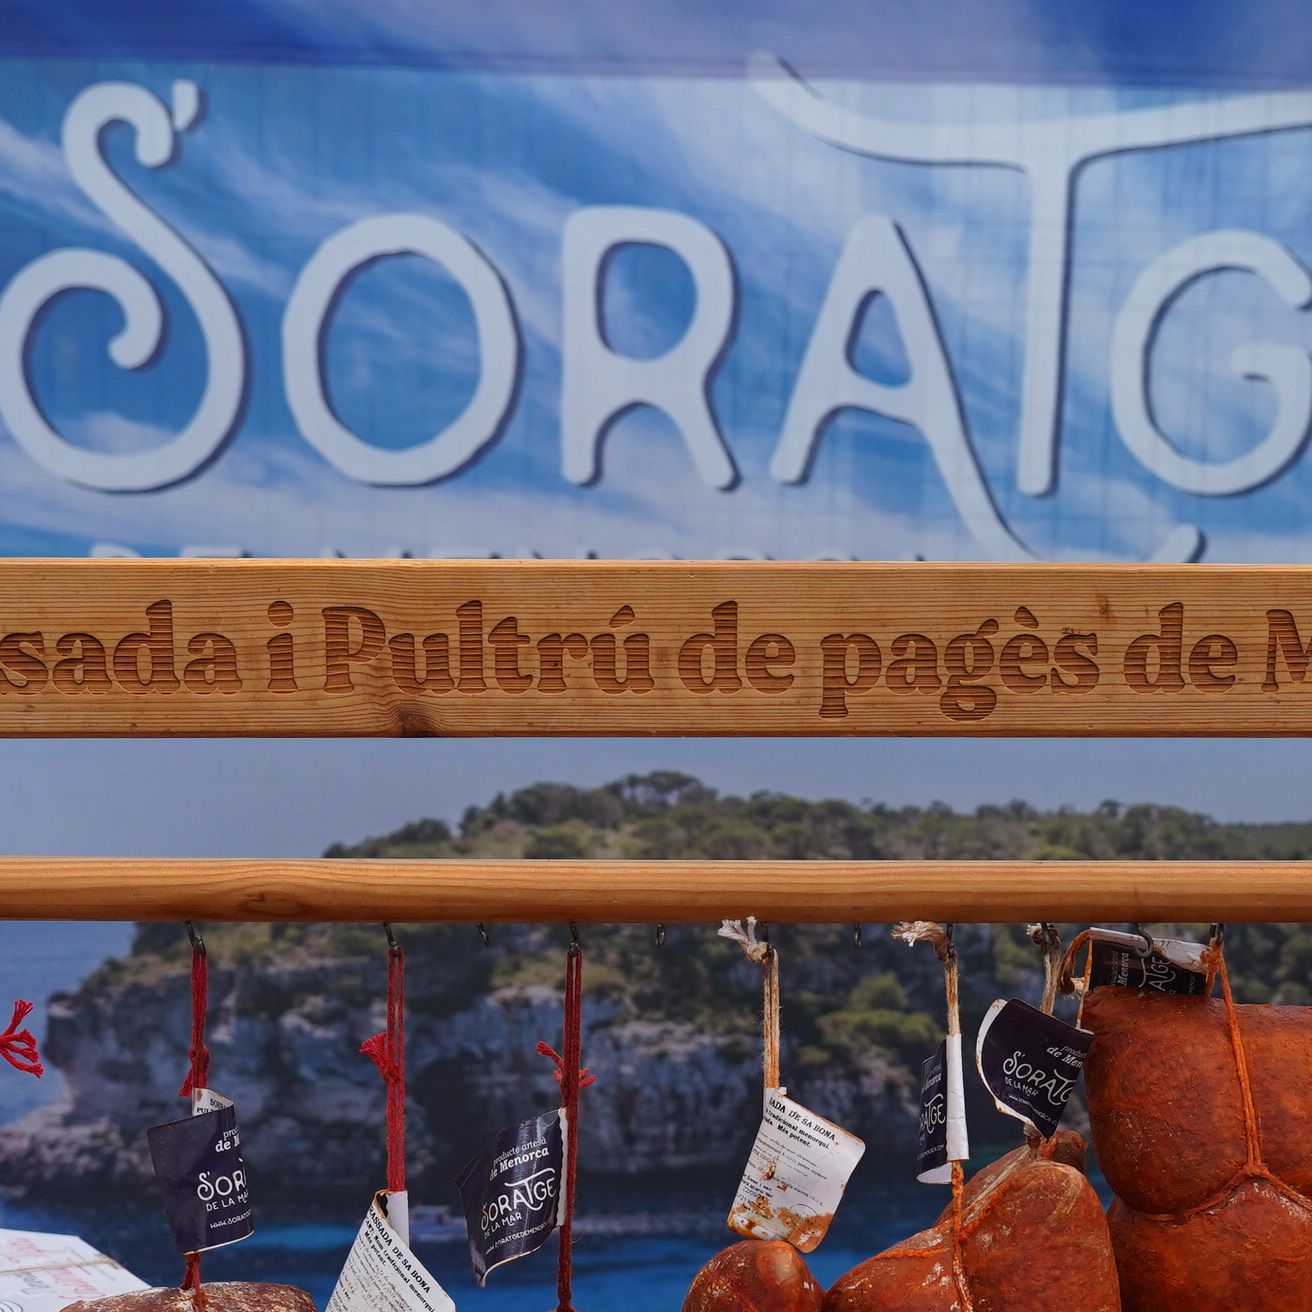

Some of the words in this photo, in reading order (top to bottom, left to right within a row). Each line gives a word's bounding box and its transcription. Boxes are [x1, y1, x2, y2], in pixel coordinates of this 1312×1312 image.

[267, 600, 295, 696] i
[321, 599, 655, 697] Pultrú
[677, 600, 797, 697] de
[818, 605, 1100, 722] pagès
[1123, 601, 1239, 697] de
[801, 1117, 813, 1129] SA
[215, 1139, 232, 1153] de
[499, 1146, 550, 1175] Menorca
[205, 1202, 220, 1212] DE
[222, 1198, 236, 1208] LA
[501, 1211, 524, 1228] MAR
[391, 1246, 405, 1261] DE
[401, 1257, 413, 1273] SA
